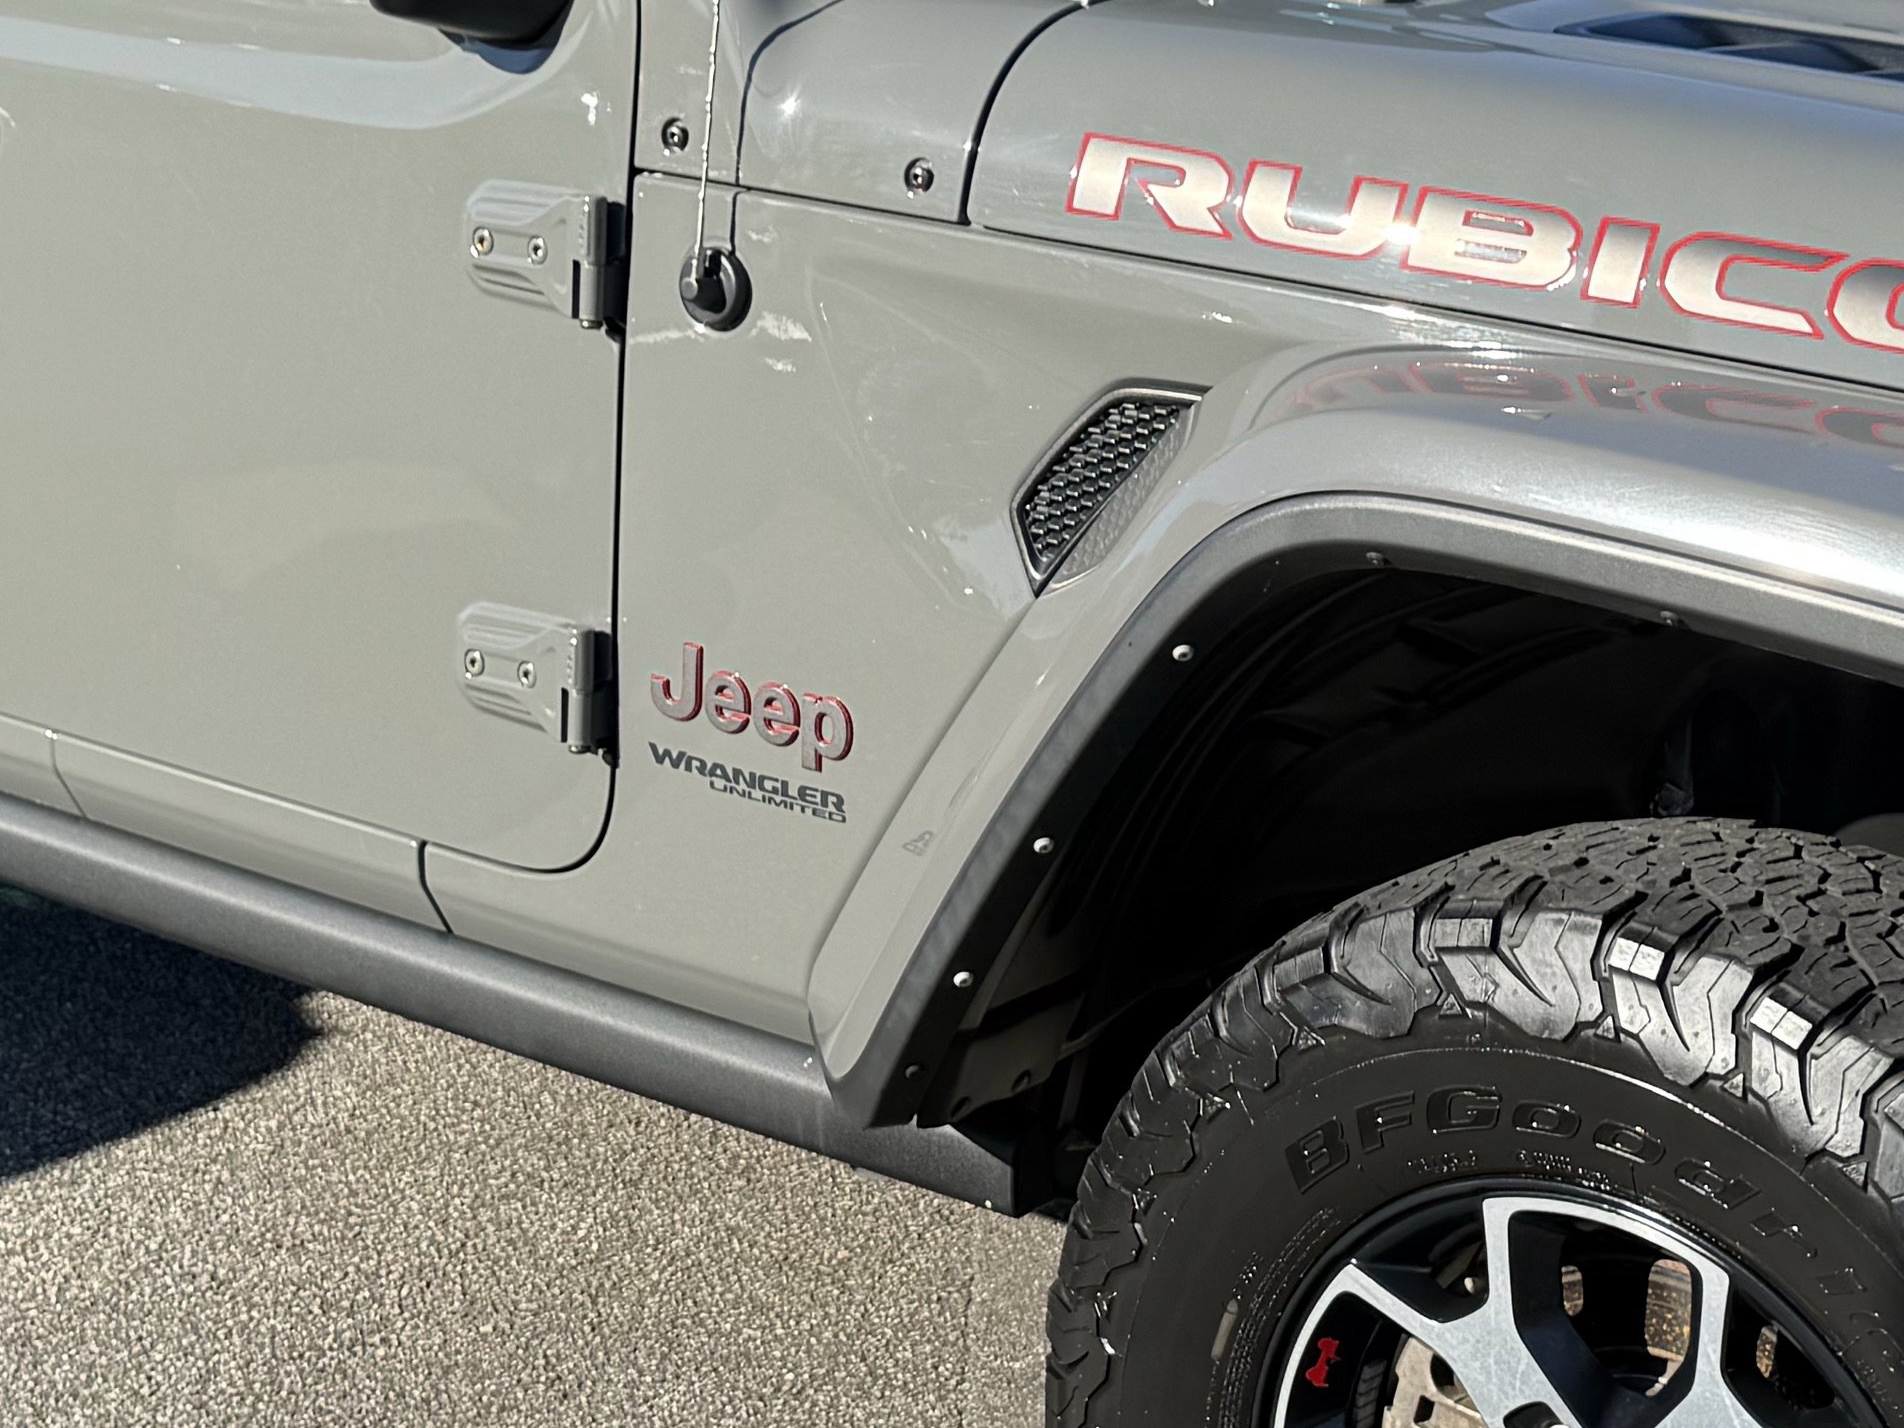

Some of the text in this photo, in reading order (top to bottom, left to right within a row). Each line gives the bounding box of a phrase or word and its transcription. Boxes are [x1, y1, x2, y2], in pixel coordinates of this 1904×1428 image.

[650, 641, 854, 773] Jeep
[648, 740, 845, 814] WRANGLER
[709, 779, 847, 824] UNLIMITED
